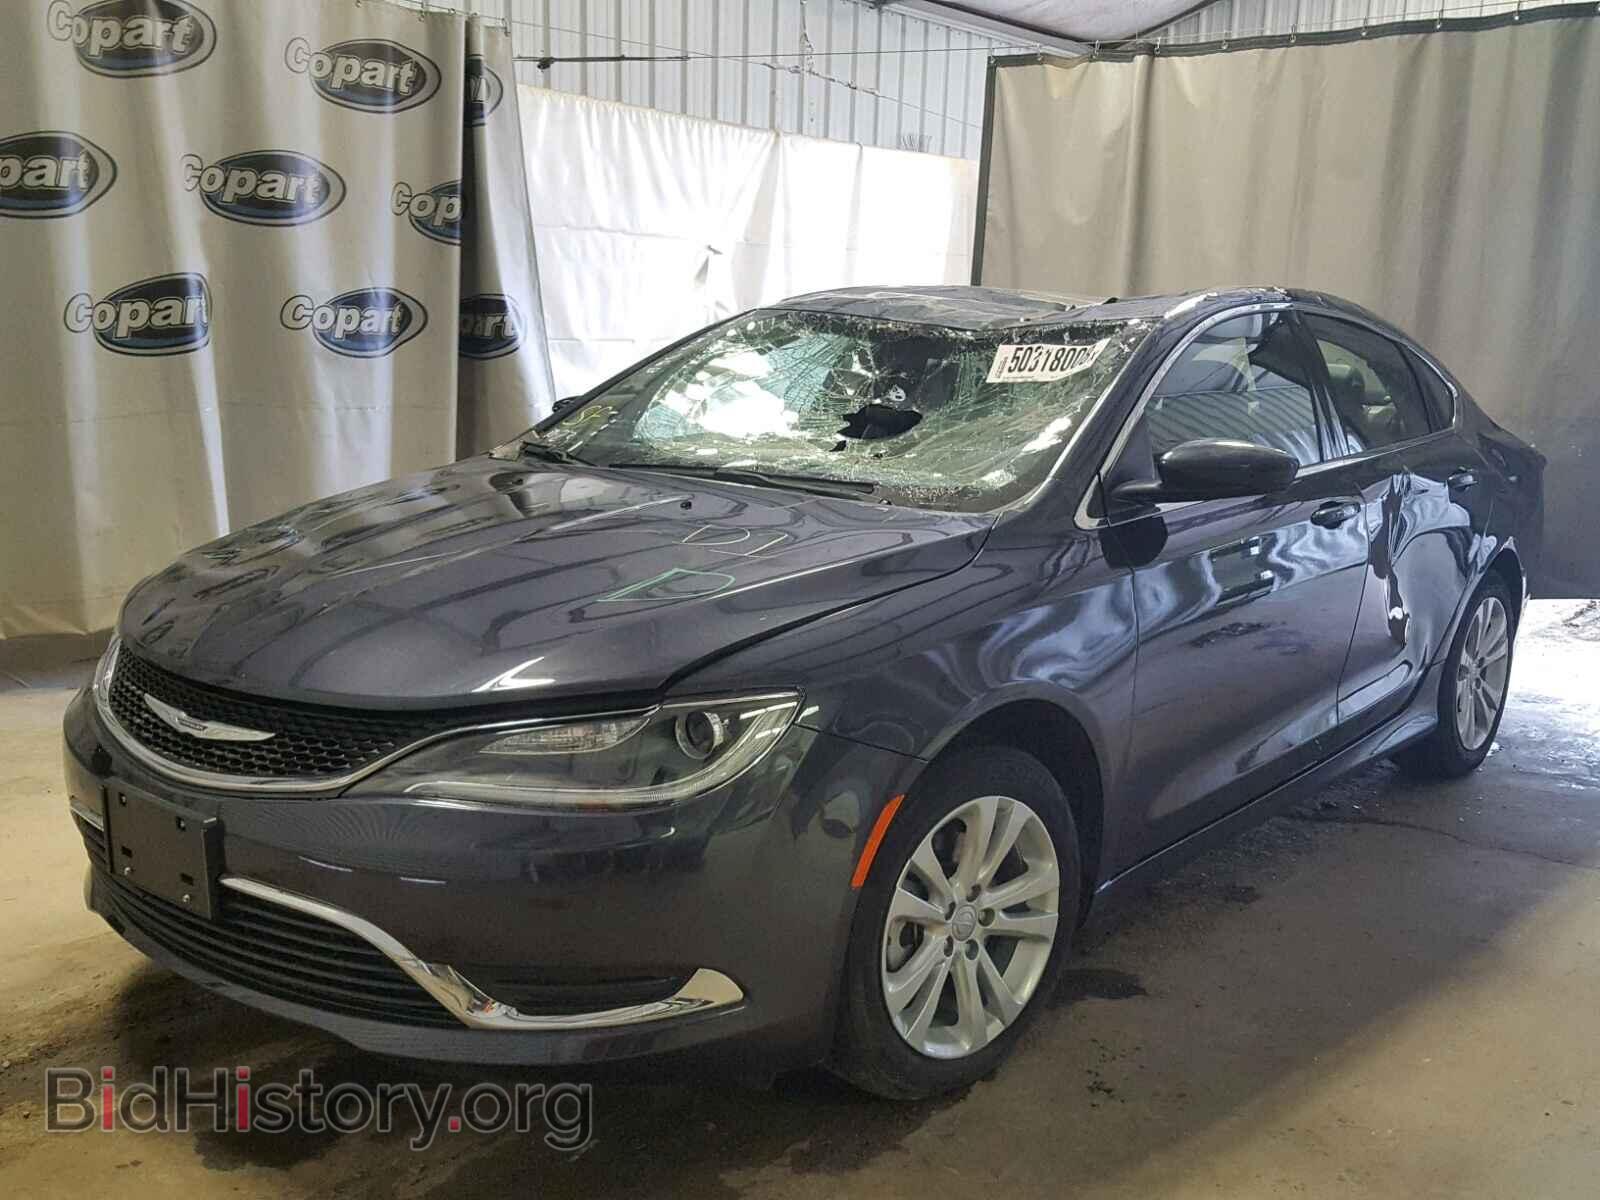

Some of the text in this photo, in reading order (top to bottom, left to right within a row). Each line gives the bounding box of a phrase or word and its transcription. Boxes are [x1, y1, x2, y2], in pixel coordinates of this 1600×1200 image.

[48, 0, 194, 57] Copart
[285, 37, 417, 94] Copart
[182, 154, 320, 206] Copart
[280, 295, 402, 341] Copart
